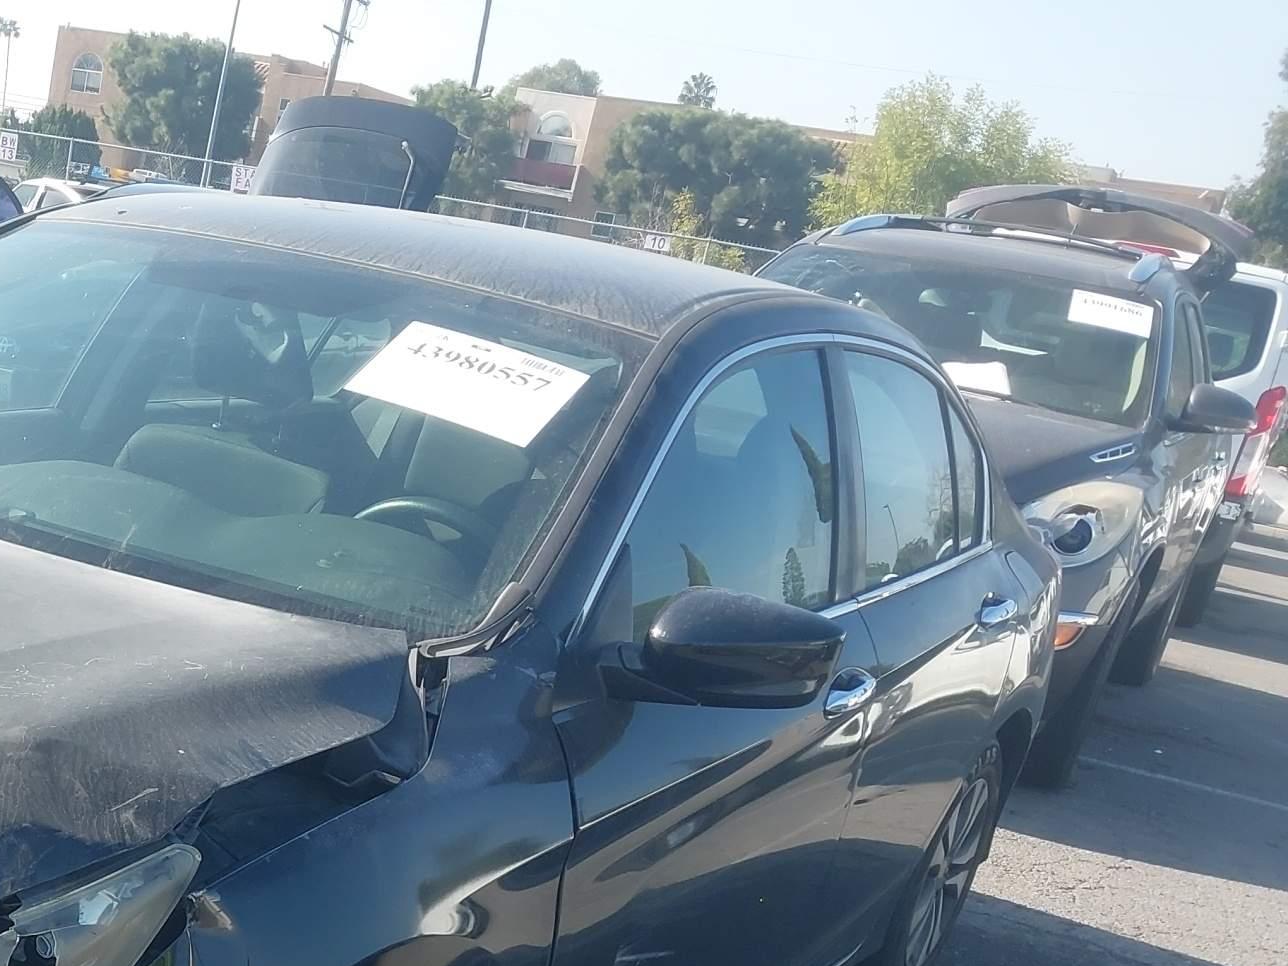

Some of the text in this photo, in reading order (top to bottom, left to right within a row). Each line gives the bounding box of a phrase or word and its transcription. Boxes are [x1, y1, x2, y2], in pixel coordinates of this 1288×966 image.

[1, 136, 17, 147] BW
[1, 149, 14, 160] 13
[651, 236, 666, 250] 10
[407, 342, 553, 392] 43980557
